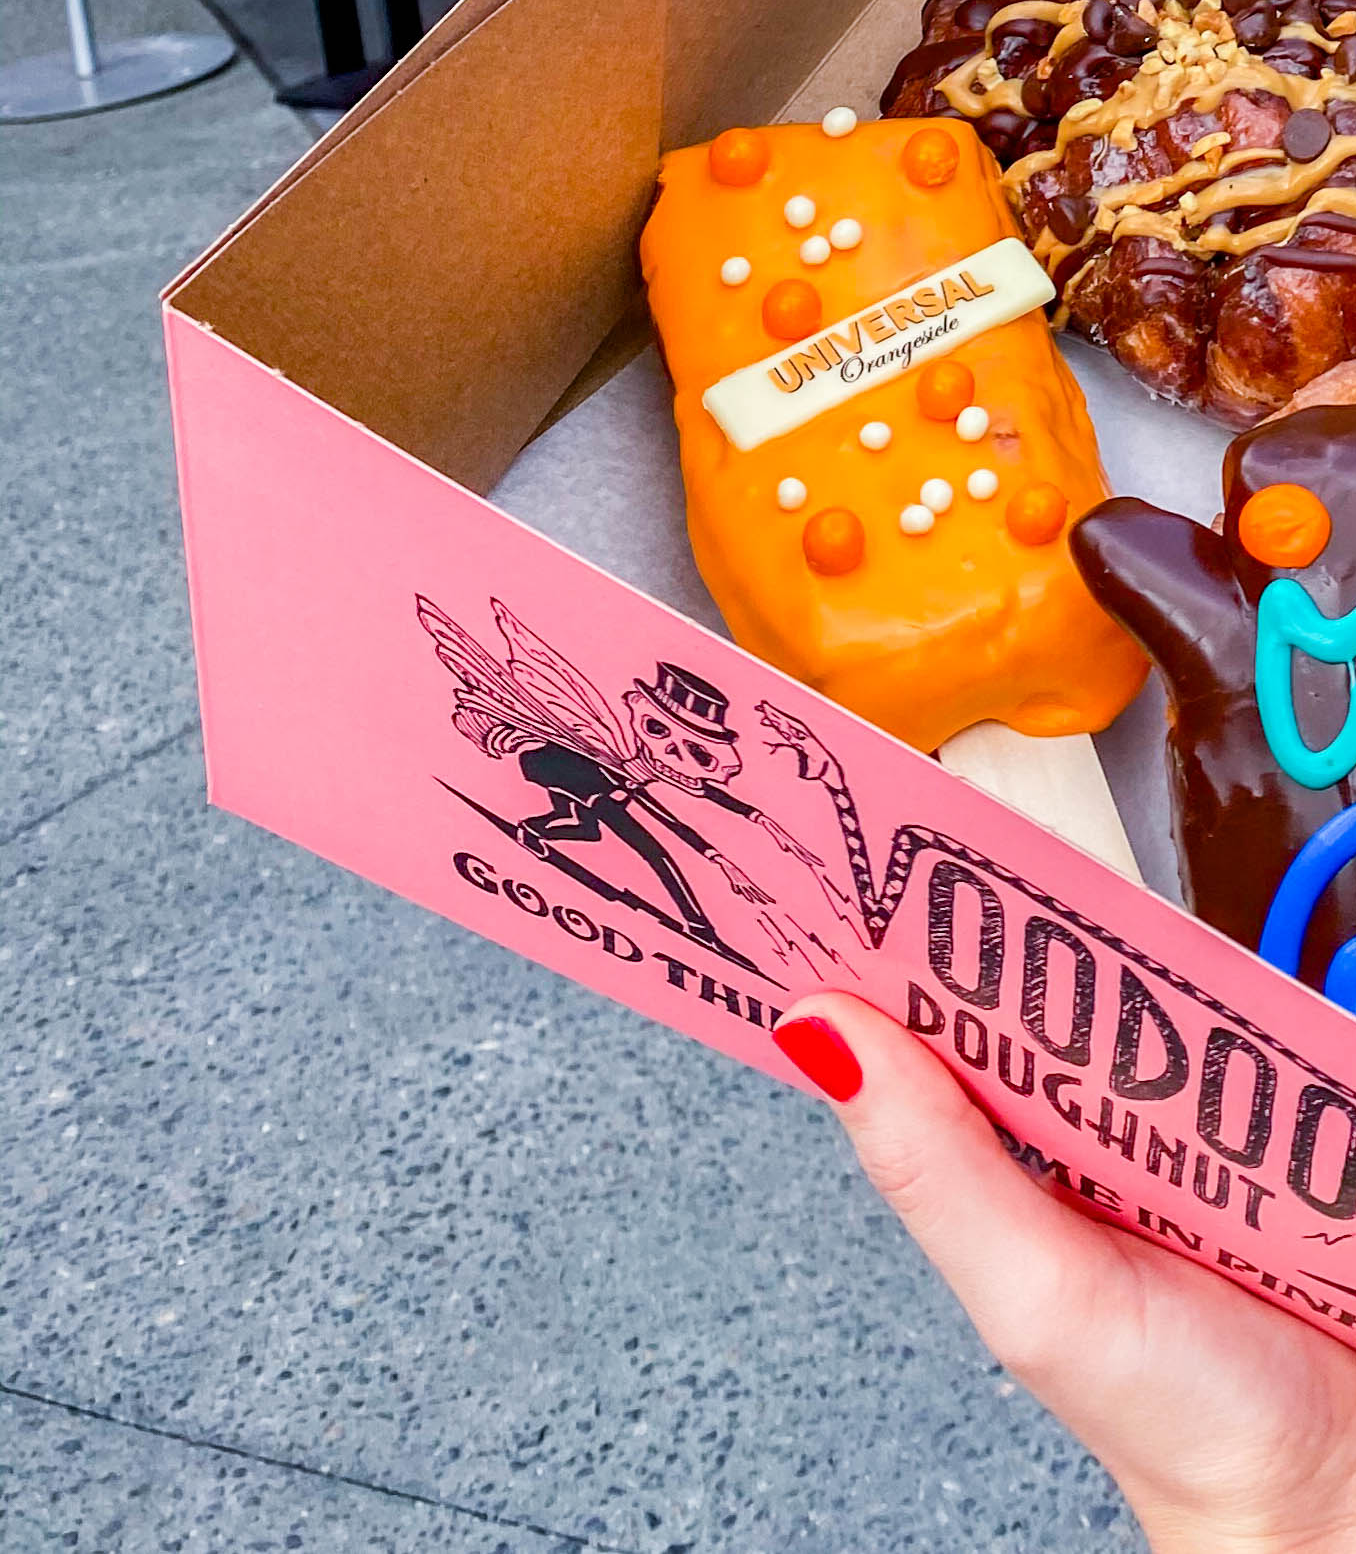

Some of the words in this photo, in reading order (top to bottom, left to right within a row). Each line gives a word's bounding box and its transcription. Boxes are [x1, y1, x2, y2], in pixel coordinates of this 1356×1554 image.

[767, 270, 995, 393] UNIVERSAL
[839, 315, 960, 383] Orangesicle
[452, 851, 645, 963] GOOD
[1138, 1205, 1204, 1252] IN
[907, 981, 1276, 1232] DOUGHNUT
